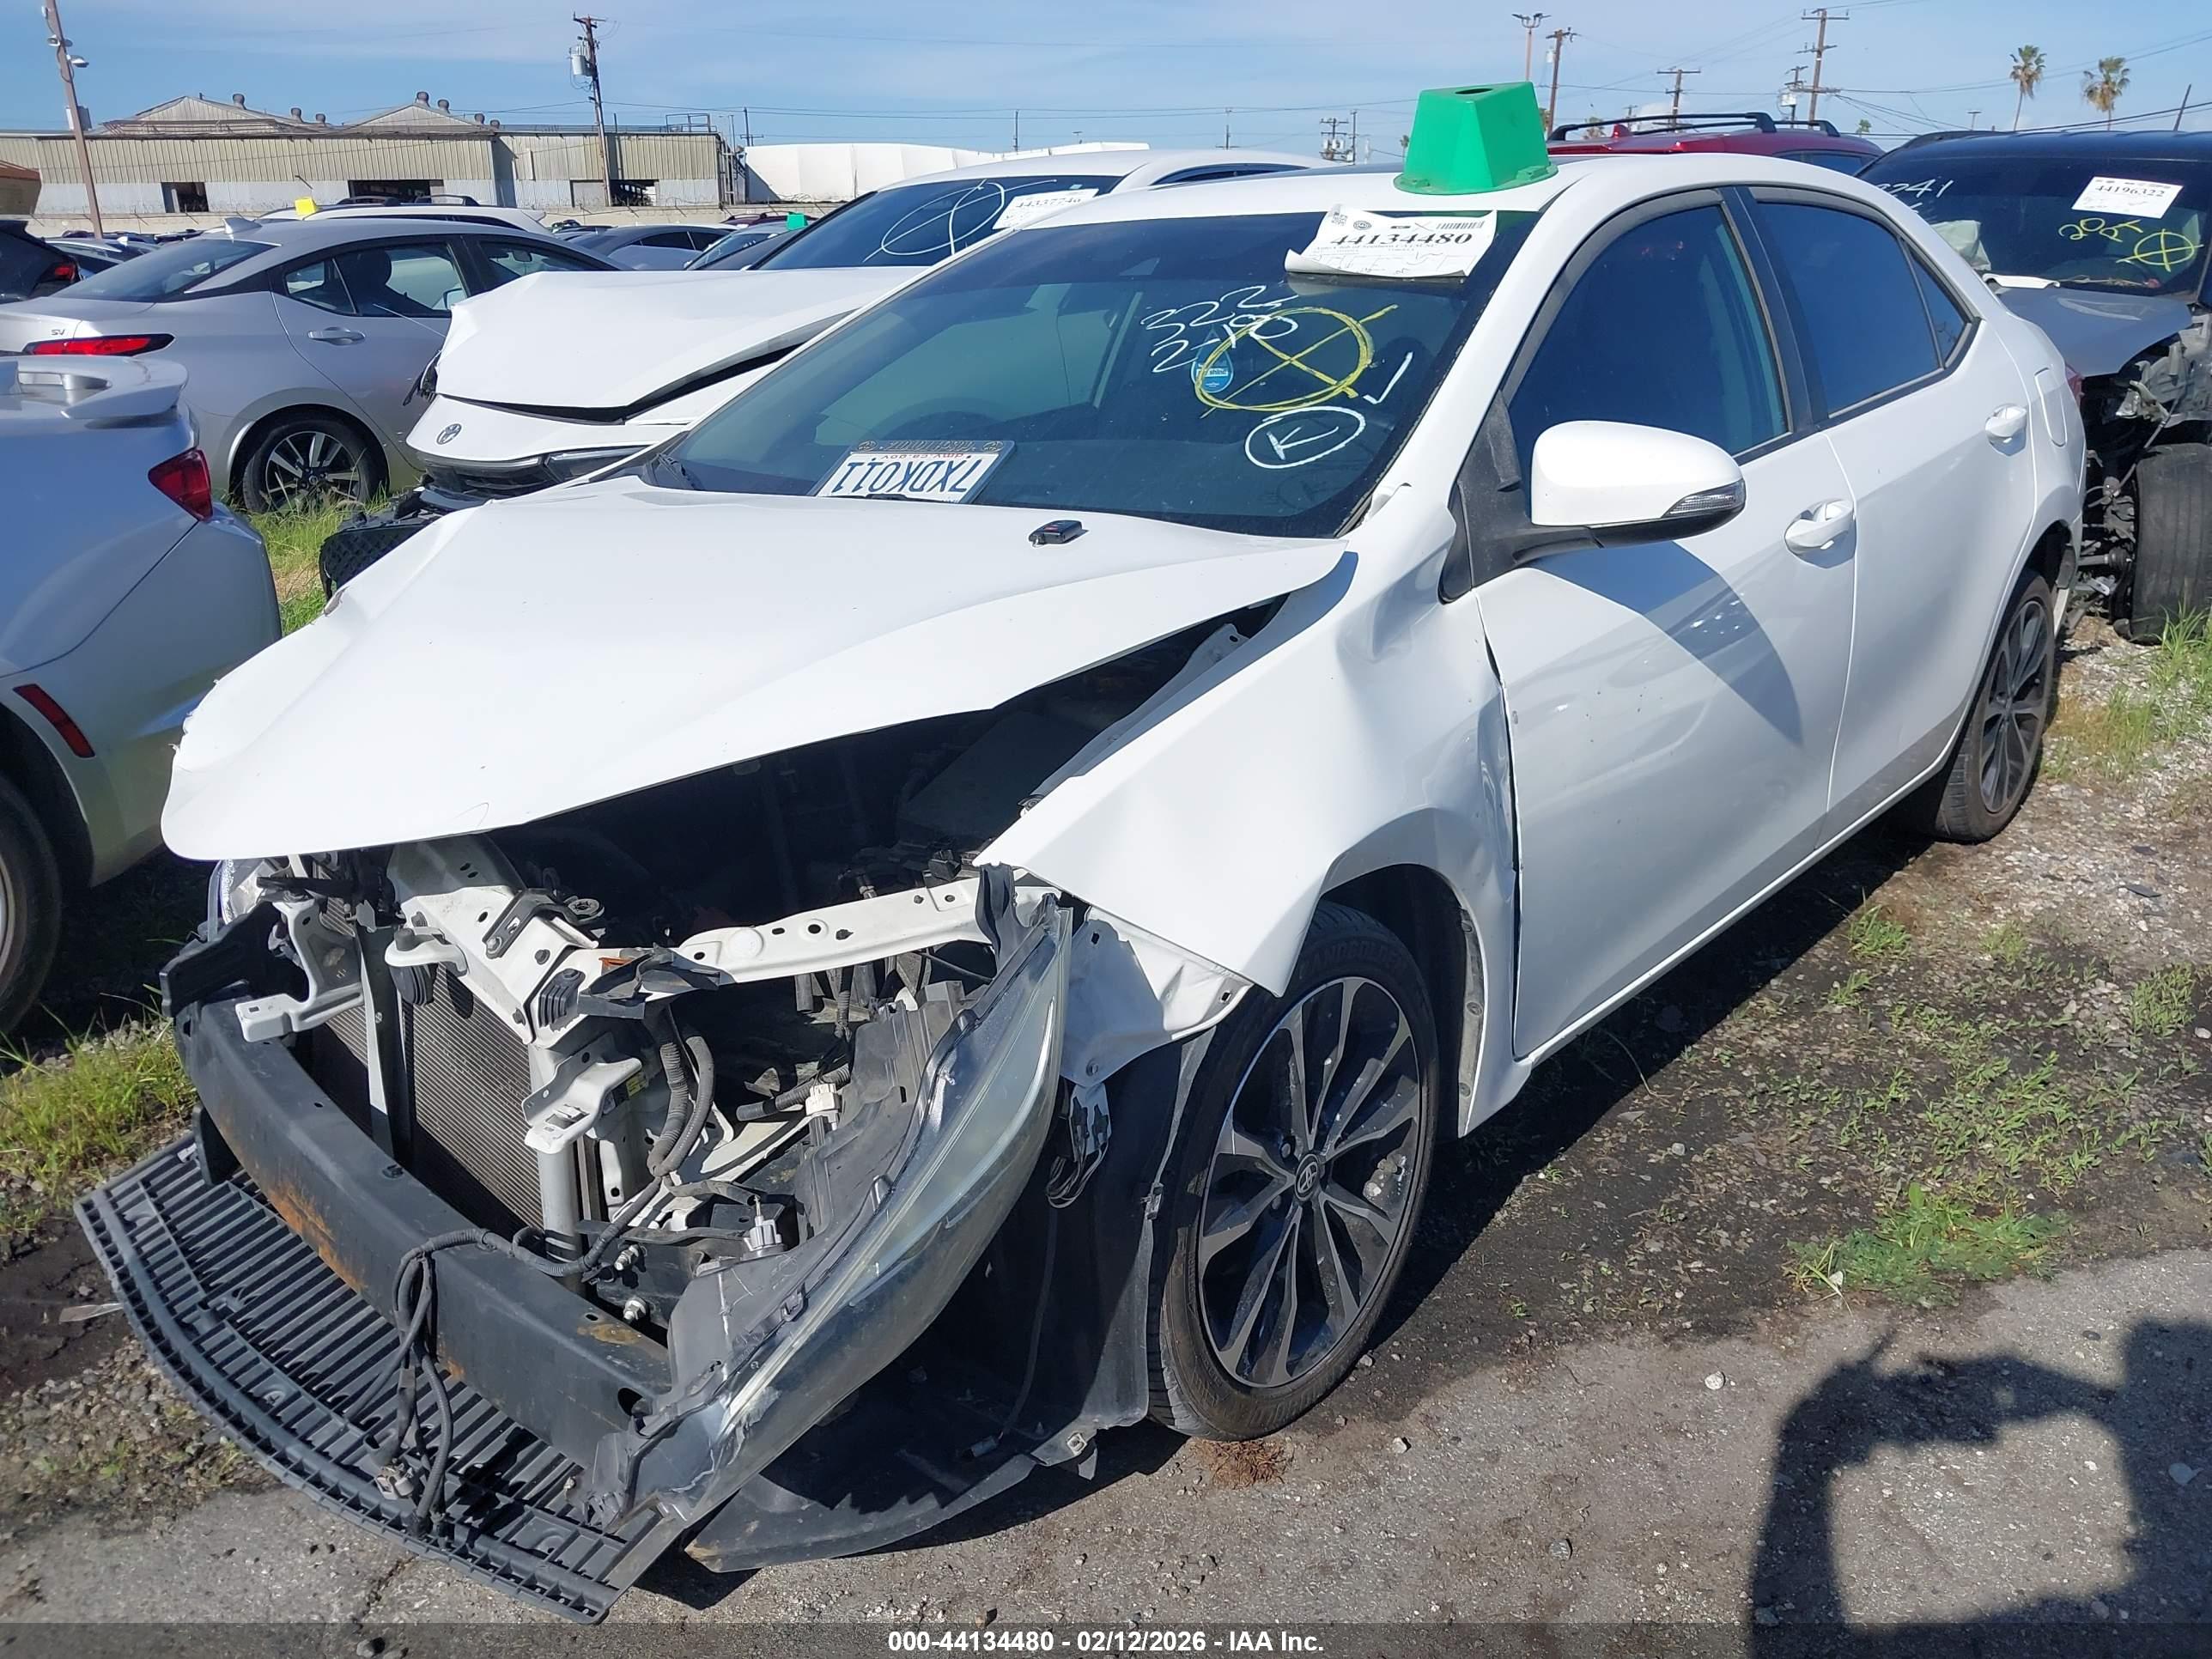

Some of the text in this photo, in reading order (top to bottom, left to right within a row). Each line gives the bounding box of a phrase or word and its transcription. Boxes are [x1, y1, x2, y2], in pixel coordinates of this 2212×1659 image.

[1330, 233, 1474, 246] 44134480
[1140, 285, 1298, 346] 322
[830, 458, 982, 494] 7XDK011
